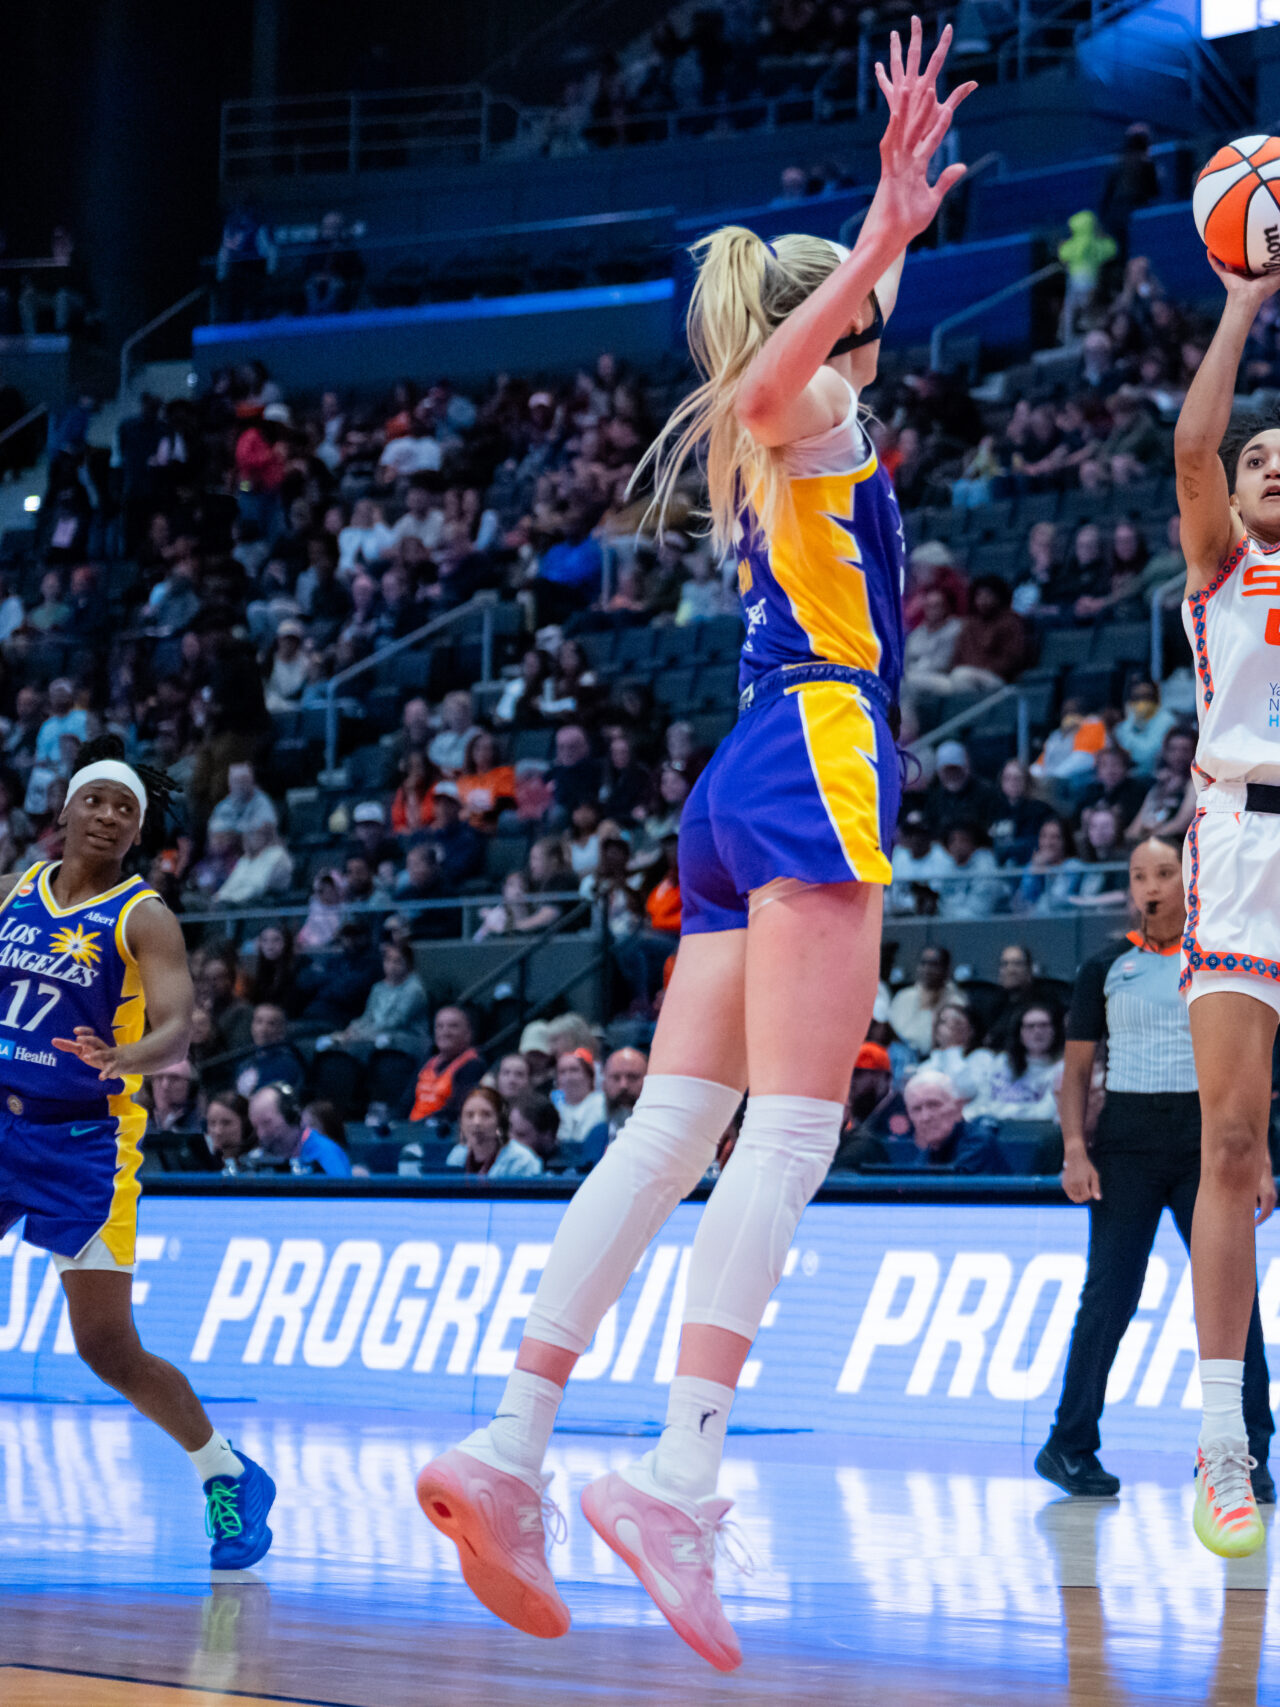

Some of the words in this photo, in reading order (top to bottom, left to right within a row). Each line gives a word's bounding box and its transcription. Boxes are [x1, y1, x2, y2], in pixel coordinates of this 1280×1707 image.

[84, 910, 116, 927] Albert
[0, 979, 61, 1033] 17
[14, 1046, 57, 1067] Health
[190, 1238, 799, 1388] PROGRESI
